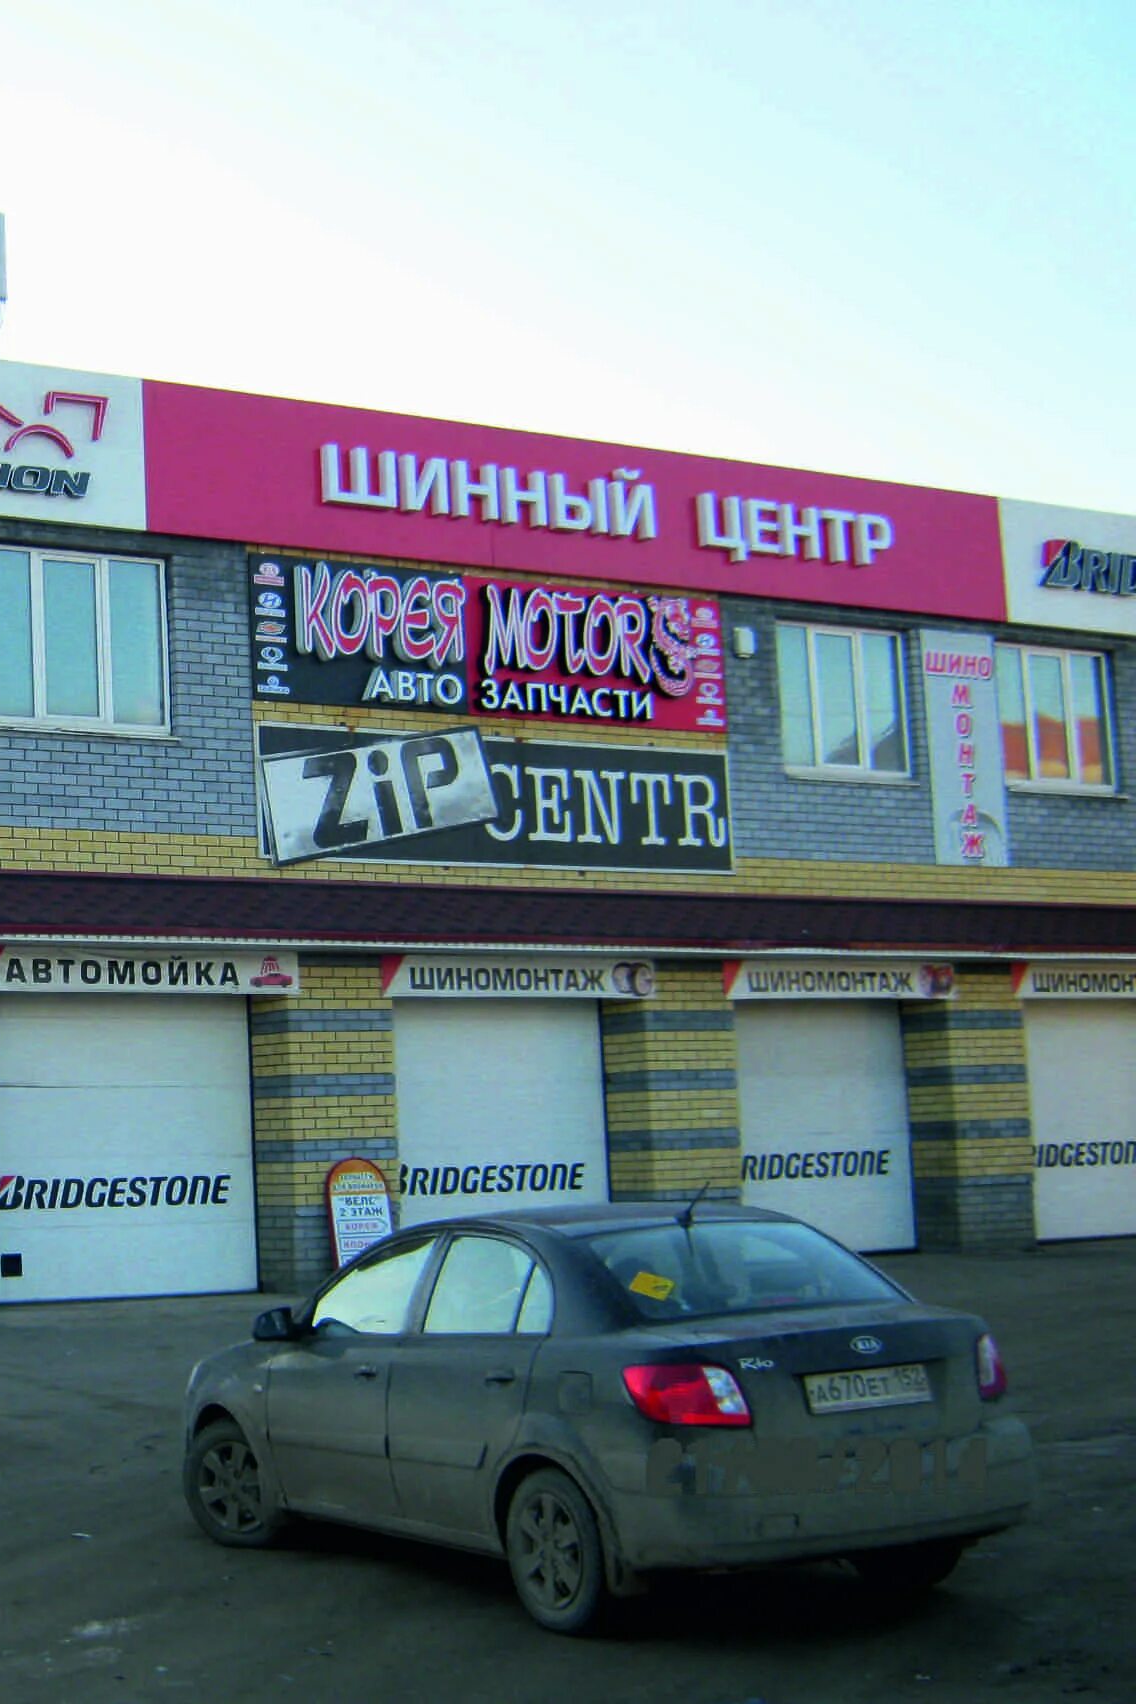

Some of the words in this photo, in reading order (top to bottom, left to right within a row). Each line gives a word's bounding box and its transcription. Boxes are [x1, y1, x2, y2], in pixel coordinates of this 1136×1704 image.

[320, 442, 657, 540] ШИННЫЙ
[695, 490, 894, 566] ЦЕНТР
[293, 559, 466, 668] КОРЕЯ
[924, 650, 993, 680] ШИНО
[362, 667, 464, 706] АВТО
[480, 678, 655, 721] ЗАПЧАСТИ
[950, 683, 986, 858] МОНТАЖ
[481, 764, 726, 848] CENTR
[5, 955, 241, 986] АВТОМОЙКА
[409, 966, 606, 992] ШИНОМОНТАЖ
[747, 970, 913, 993] ШИНОМОНТАЖ
[738, 1357, 775, 1370] Rio
